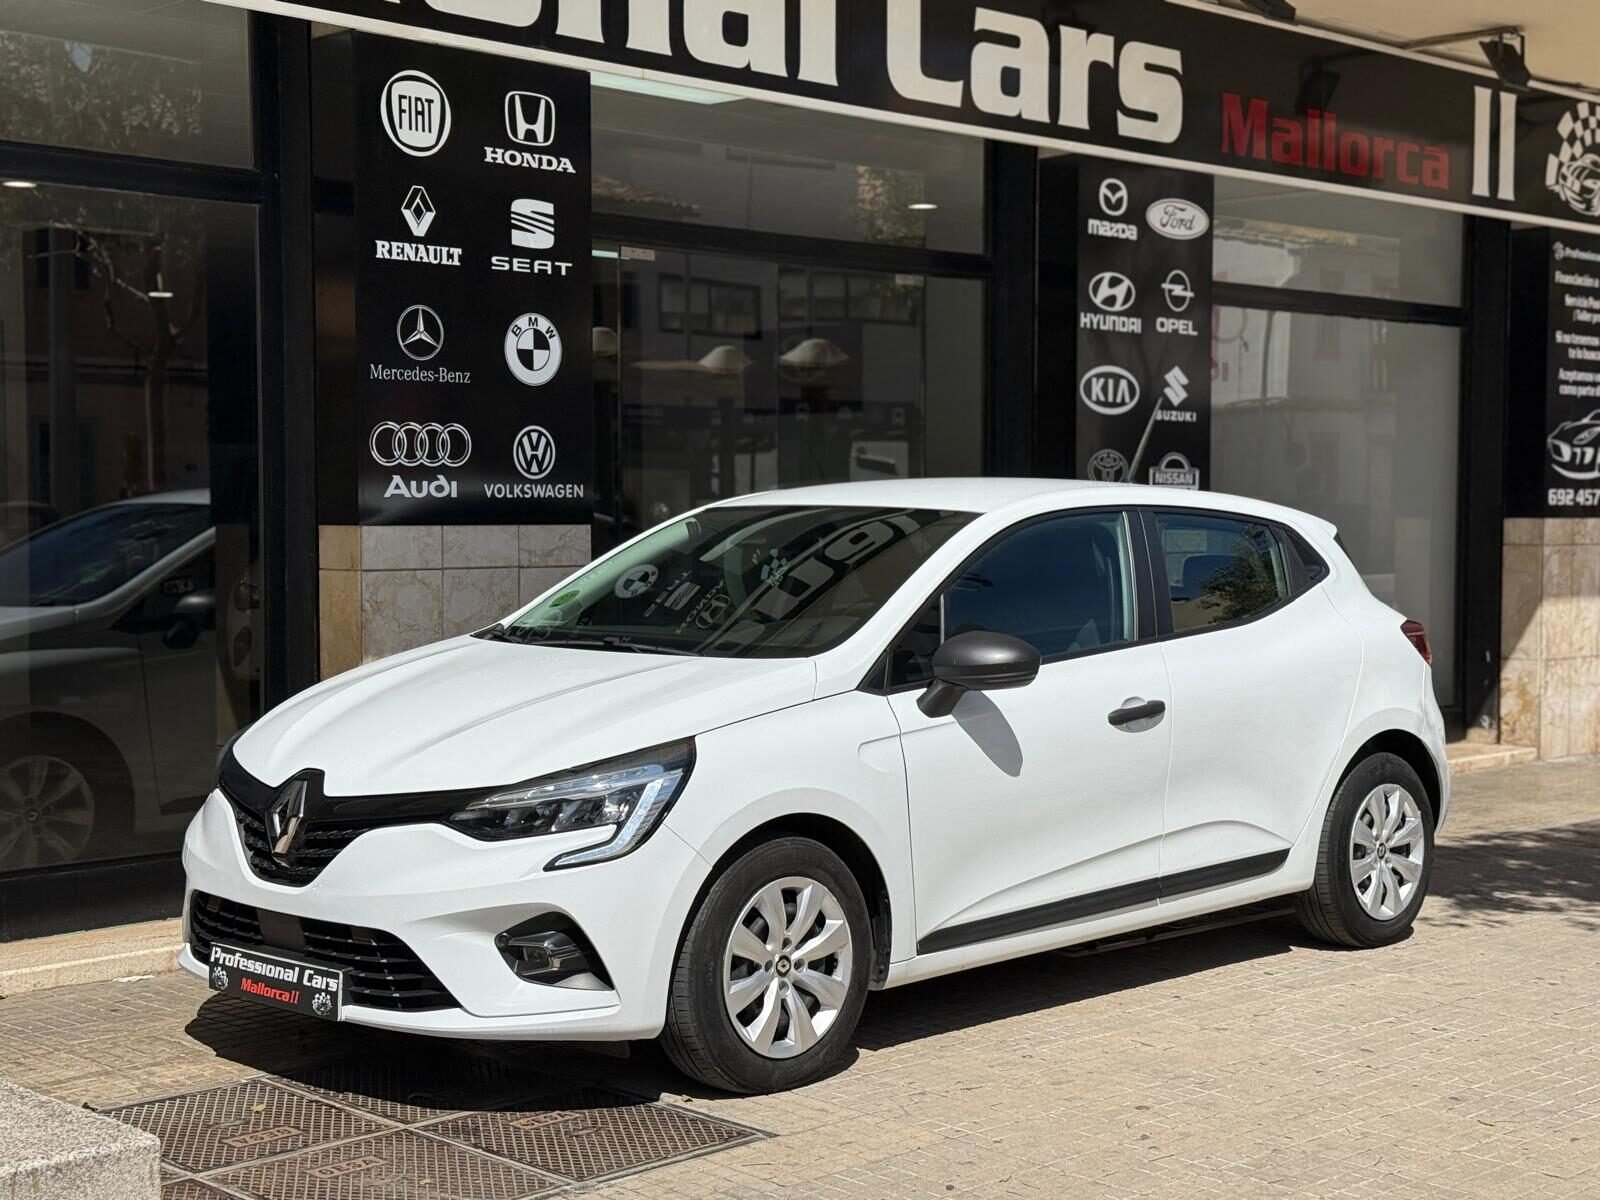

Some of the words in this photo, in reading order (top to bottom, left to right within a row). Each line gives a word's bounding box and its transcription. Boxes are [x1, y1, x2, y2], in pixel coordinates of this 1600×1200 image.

[886, 0, 1183, 143] Cars
[1221, 92, 1449, 191] Mallorca
[397, 94, 434, 133] FIAT
[483, 147, 576, 173] HONDA
[1160, 204, 1195, 230] Ford
[375, 240, 462, 266] RENAULT
[491, 256, 572, 276] SEAT
[511, 316, 556, 340] BMW
[1080, 312, 1142, 333] HYUNDAI
[1156, 317, 1198, 336] OPEL
[370, 364, 471, 384] Mercedes-Benz
[1091, 377, 1130, 403] KIA
[1155, 410, 1197, 422] SUZUKI
[384, 474, 458, 498] Audi
[484, 483, 583, 498] VOLKSWAGEN
[1155, 472, 1193, 485] NISSAN
[1547, 488, 1575, 506] 692
[210, 946, 299, 983] Professional
[303, 970, 338, 992] Cars
[240, 978, 290, 1002] Mallorca
